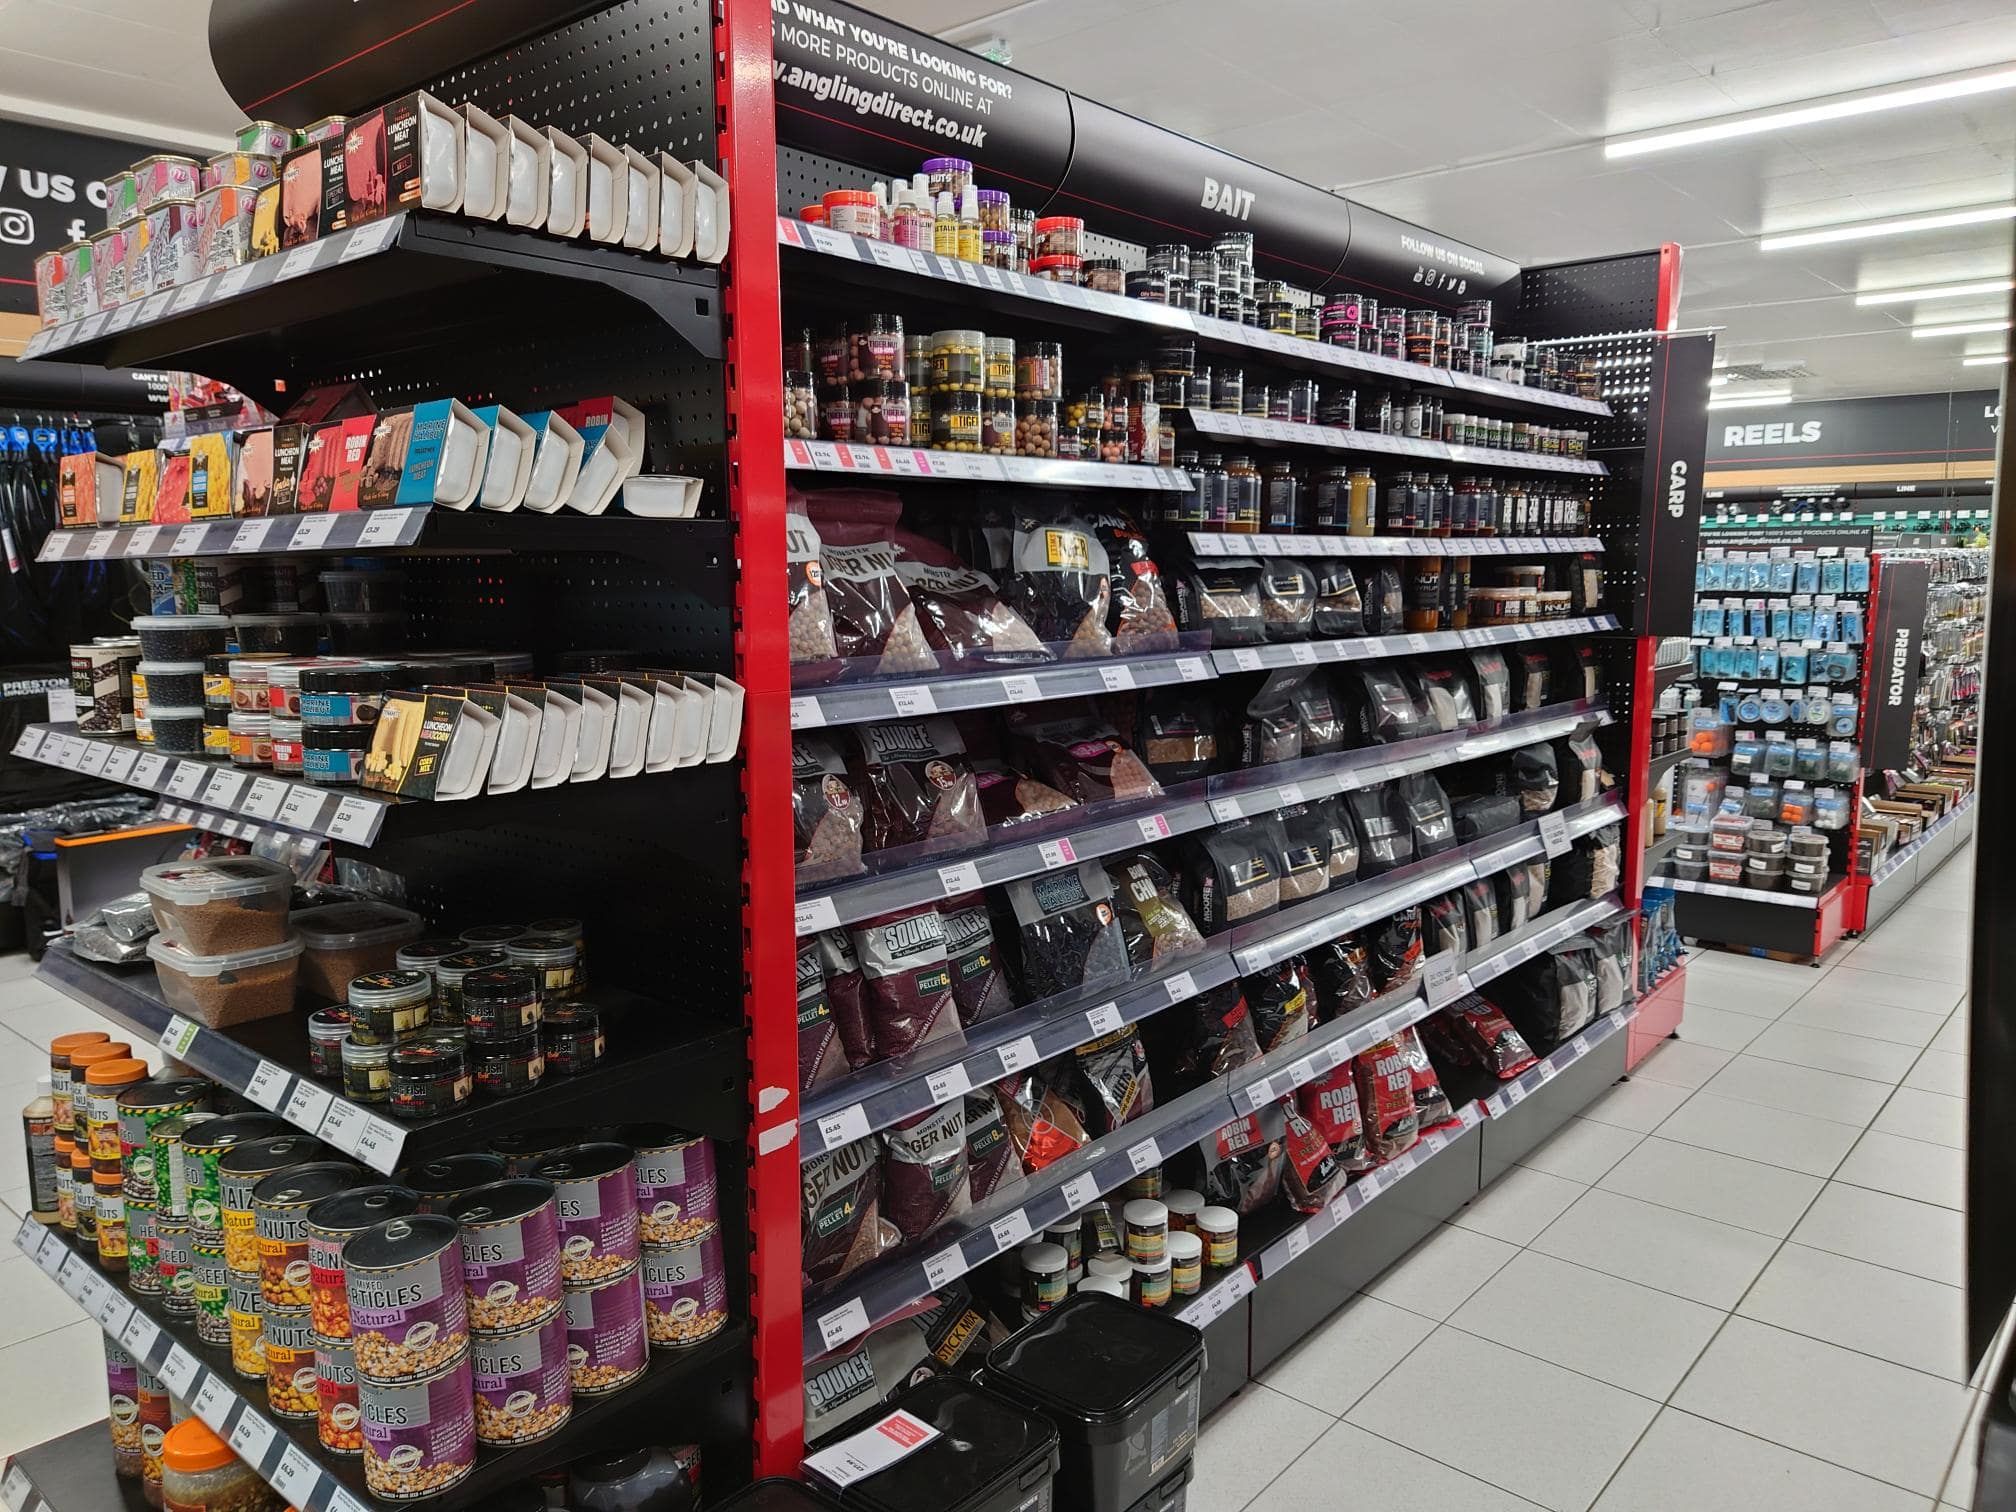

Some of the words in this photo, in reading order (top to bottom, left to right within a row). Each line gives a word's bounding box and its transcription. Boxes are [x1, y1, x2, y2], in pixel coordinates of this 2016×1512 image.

[795, 2, 847, 35] WHAT
[849, 23, 910, 61] YOU'RE
[912, 48, 976, 85] LOOKING
[978, 74, 1014, 99] FOR?
[781, 23, 831, 58] MORE
[836, 41, 919, 88] PRODUCTS
[922, 75, 975, 110] ONLINE
[976, 97, 994, 116] AT
[387, 115, 417, 136] LUNCHEON
[394, 128, 410, 143] MEAT
[18, 168, 77, 203] US
[1201, 176, 1256, 221] BAIT
[1401, 234, 1434, 258] FOLLOW
[1435, 246, 1446, 262] US
[1447, 251, 1458, 266] ON
[1459, 255, 1485, 276] SOCIAL
[345, 435, 368, 449] ROBIN
[1723, 420, 1823, 447] REELS
[274, 447, 299, 457] LUNCHEON
[281, 455, 294, 465] MEAT
[347, 449, 361, 462] RED
[1668, 461, 1688, 518] CARP
[1888, 628, 1909, 706] PREDATOR
[3, 678, 70, 690] PRESTON
[423, 720, 451, 732] LUNCHEON
[869, 723, 935, 753] SOURCE
[884, 914, 943, 951] SOURCE
[919, 979, 941, 991] PELLET
[1387, 1073, 1412, 1091] RED
[916, 1115, 946, 1136] MONSTER
[943, 1112, 964, 1141] NUT
[1221, 1117, 1251, 1141] ROBIN
[1227, 1135, 1250, 1152] RED
[263, 1219, 309, 1241] NUTS
[819, 1209, 845, 1231] PELLET
[356, 1279, 384, 1290] MIXED
[353, 1310, 402, 1326] Natural
[937, 1331, 964, 1362] STICK
[959, 1309, 979, 1336] MIX
[805, 1351, 874, 1407] SOURCE
